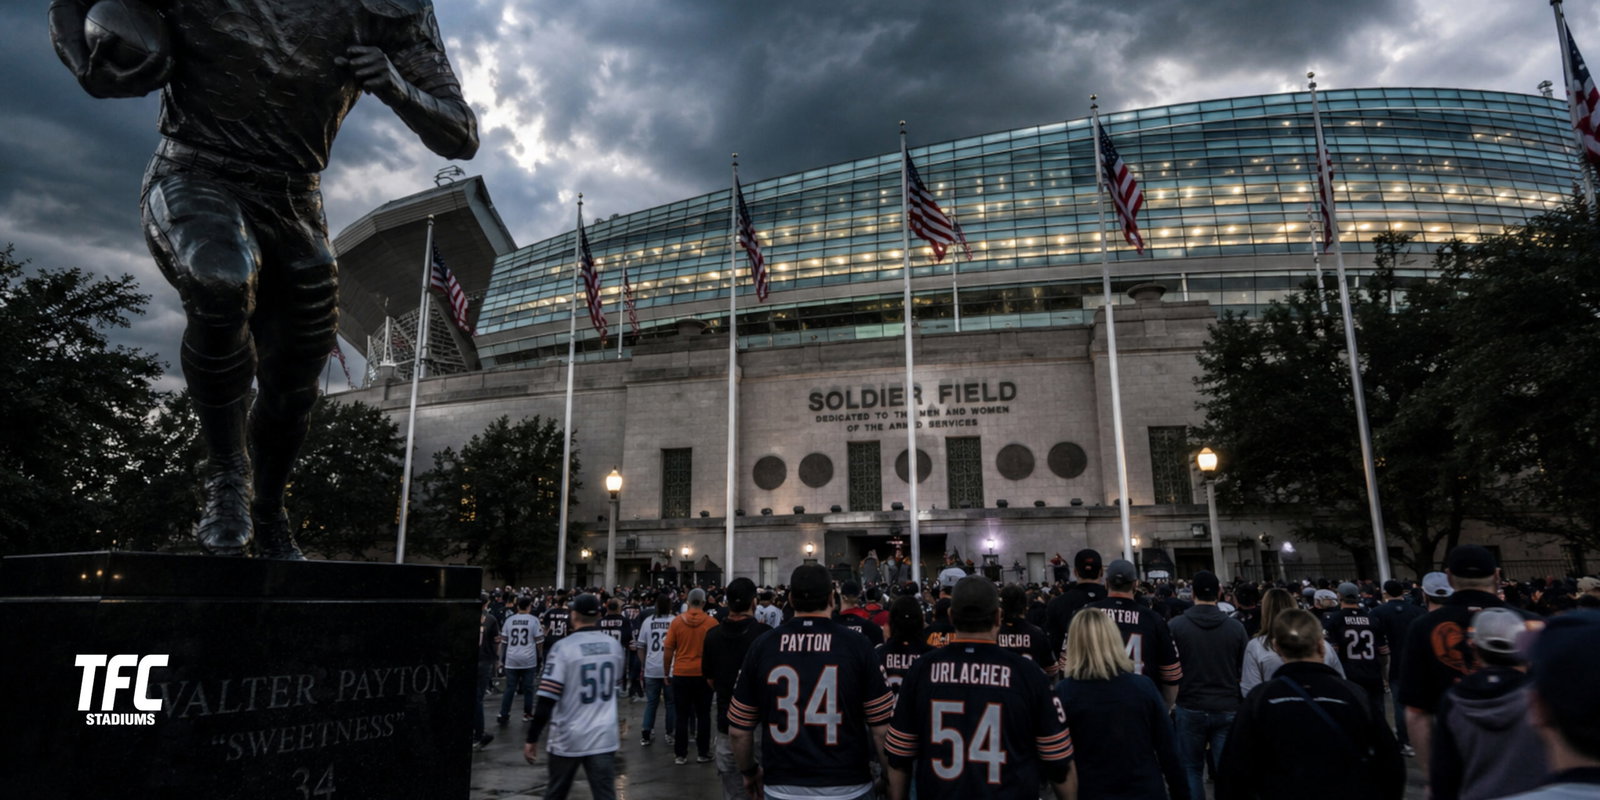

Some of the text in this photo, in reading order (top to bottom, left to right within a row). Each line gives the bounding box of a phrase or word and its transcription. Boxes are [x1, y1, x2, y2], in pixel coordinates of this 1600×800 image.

[808, 381, 1017, 412] SOLDIER FIELD
[815, 412, 870, 423] DEDICATED
[874, 411, 889, 420] TO
[919, 408, 940, 417] MEN
[945, 406, 966, 416] AND
[970, 405, 1010, 415] WOMEN
[846, 423, 860, 432] OF
[864, 422, 884, 432] THE
[928, 418, 978, 429] SERVICES
[779, 633, 832, 654] PAYTON
[1343, 628, 1375, 661] 23
[334, 663, 452, 703] PAYTON
[580, 661, 615, 704] 50
[930, 661, 1011, 688] URLACHER
[766, 664, 843, 746] 34
[930, 699, 1007, 785] 54
[290, 761, 337, 800] 34
